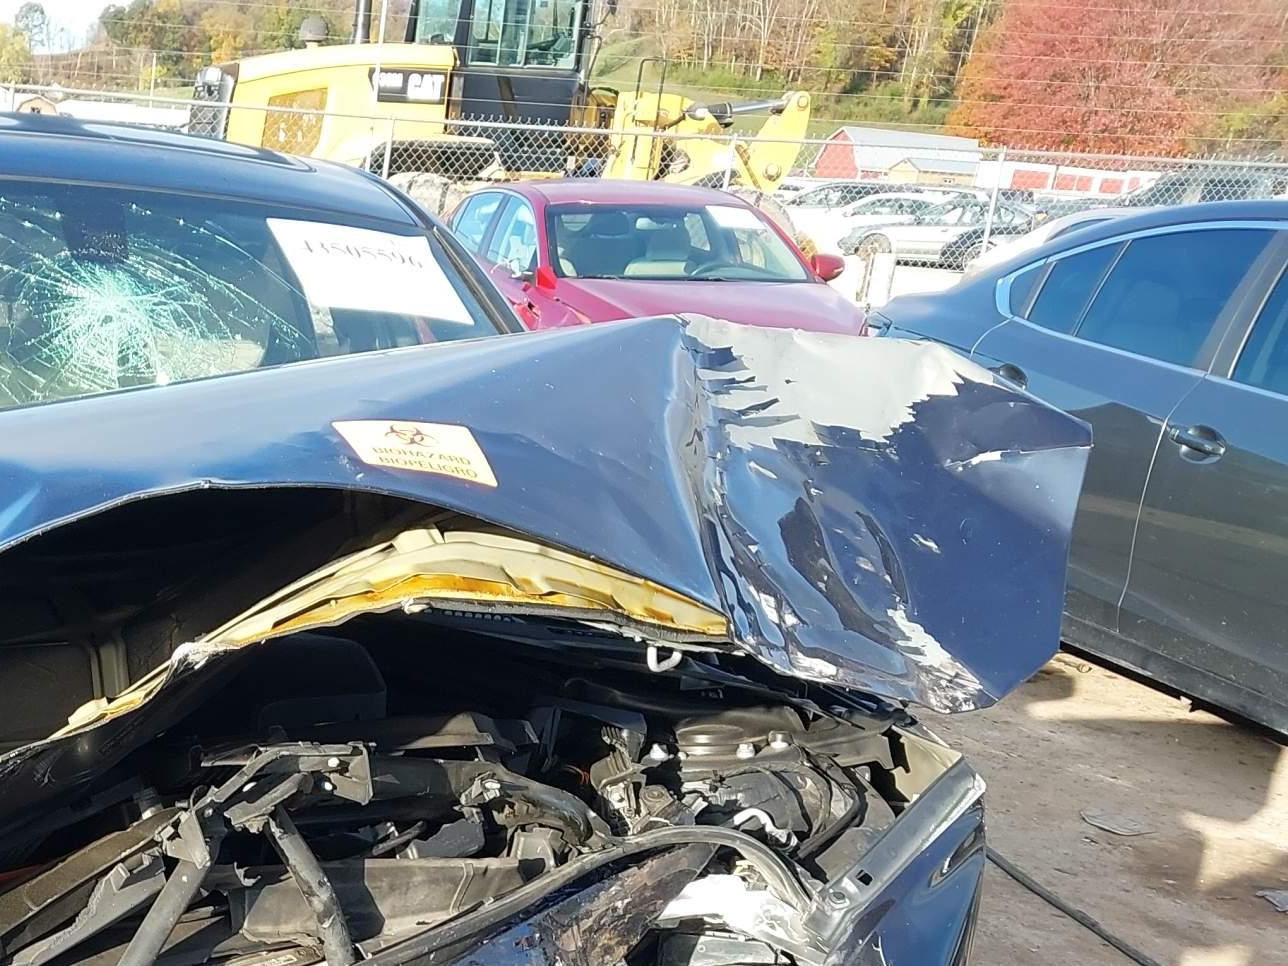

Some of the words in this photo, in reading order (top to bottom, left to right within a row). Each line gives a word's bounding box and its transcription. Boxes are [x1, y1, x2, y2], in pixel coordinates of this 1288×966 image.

[407, 73, 445, 100] CAT
[372, 446, 472, 466] BIOHAZARD
[378, 456, 478, 479] BIOPELIGRO
